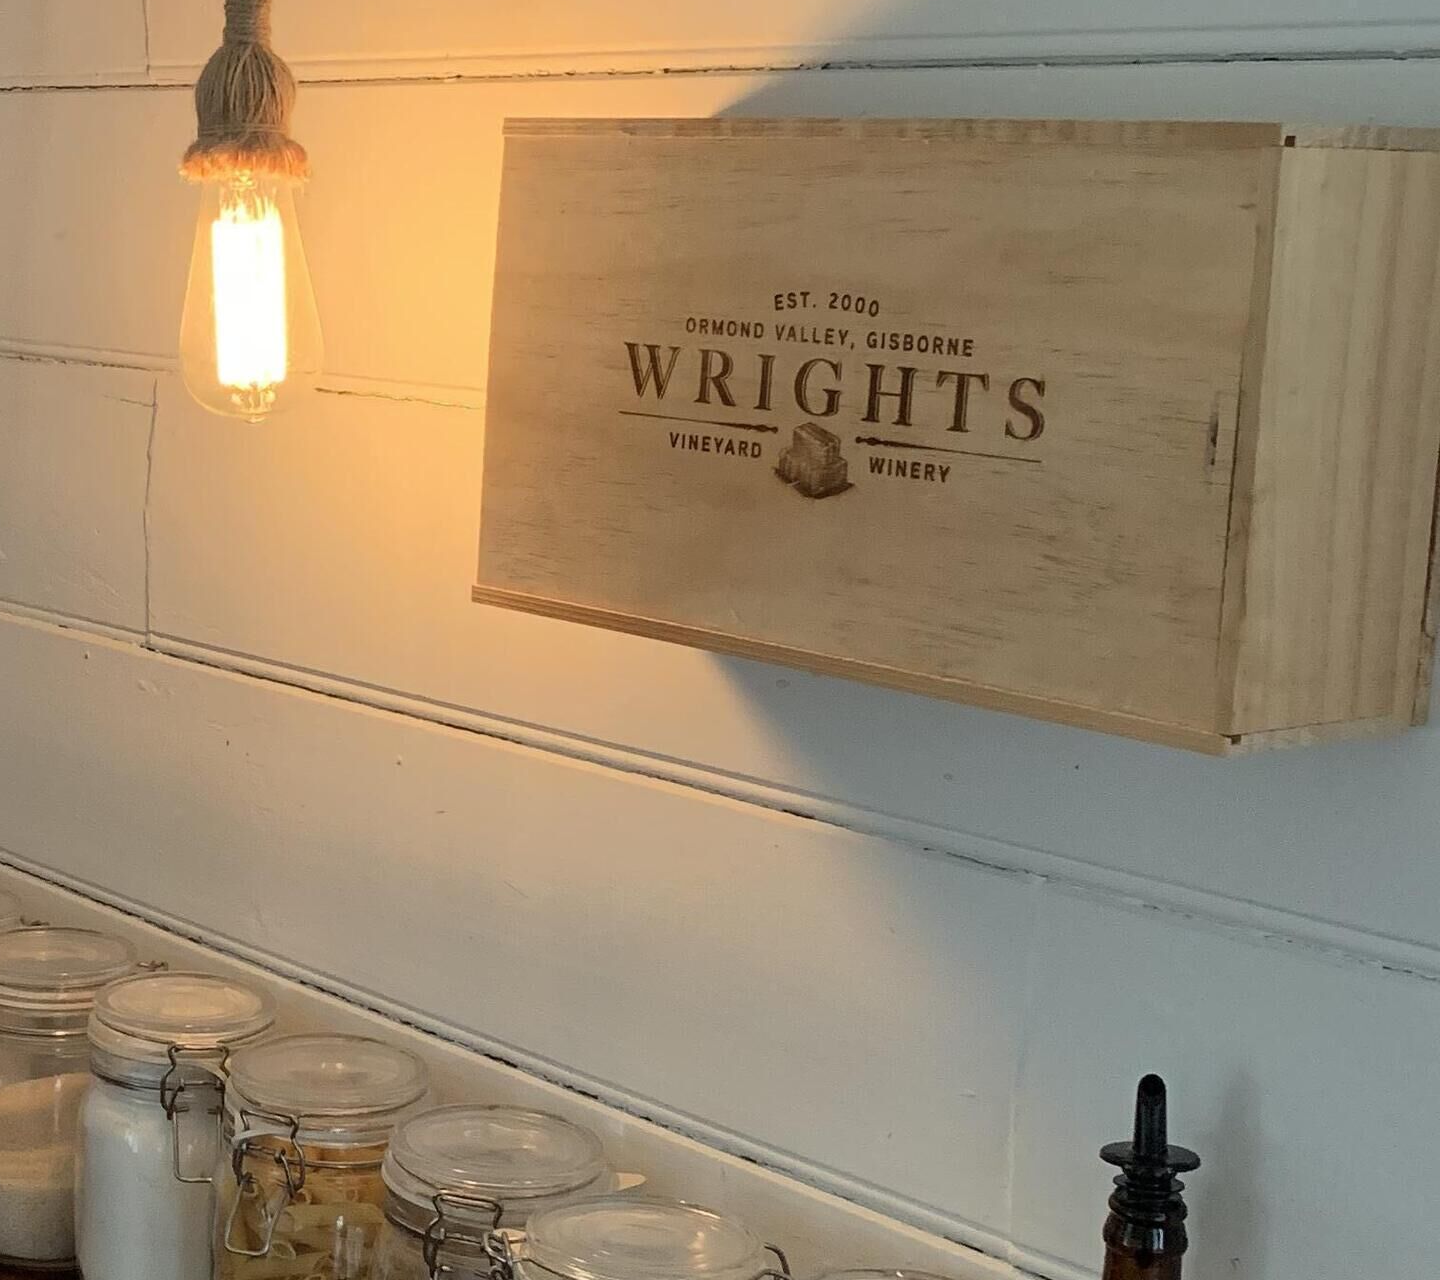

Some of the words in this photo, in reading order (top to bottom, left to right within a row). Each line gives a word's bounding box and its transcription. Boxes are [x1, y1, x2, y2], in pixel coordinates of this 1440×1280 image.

[773, 291, 817, 311] EST.
[829, 292, 880, 317] 2000
[685, 317, 765, 340] ORMOND
[775, 324, 856, 351] VALLEY,
[866, 331, 975, 357] GISBORNE
[624, 341, 1046, 441] WRIGHTS
[669, 431, 762, 459] VINEYARD
[868, 456, 952, 483] WINERY
